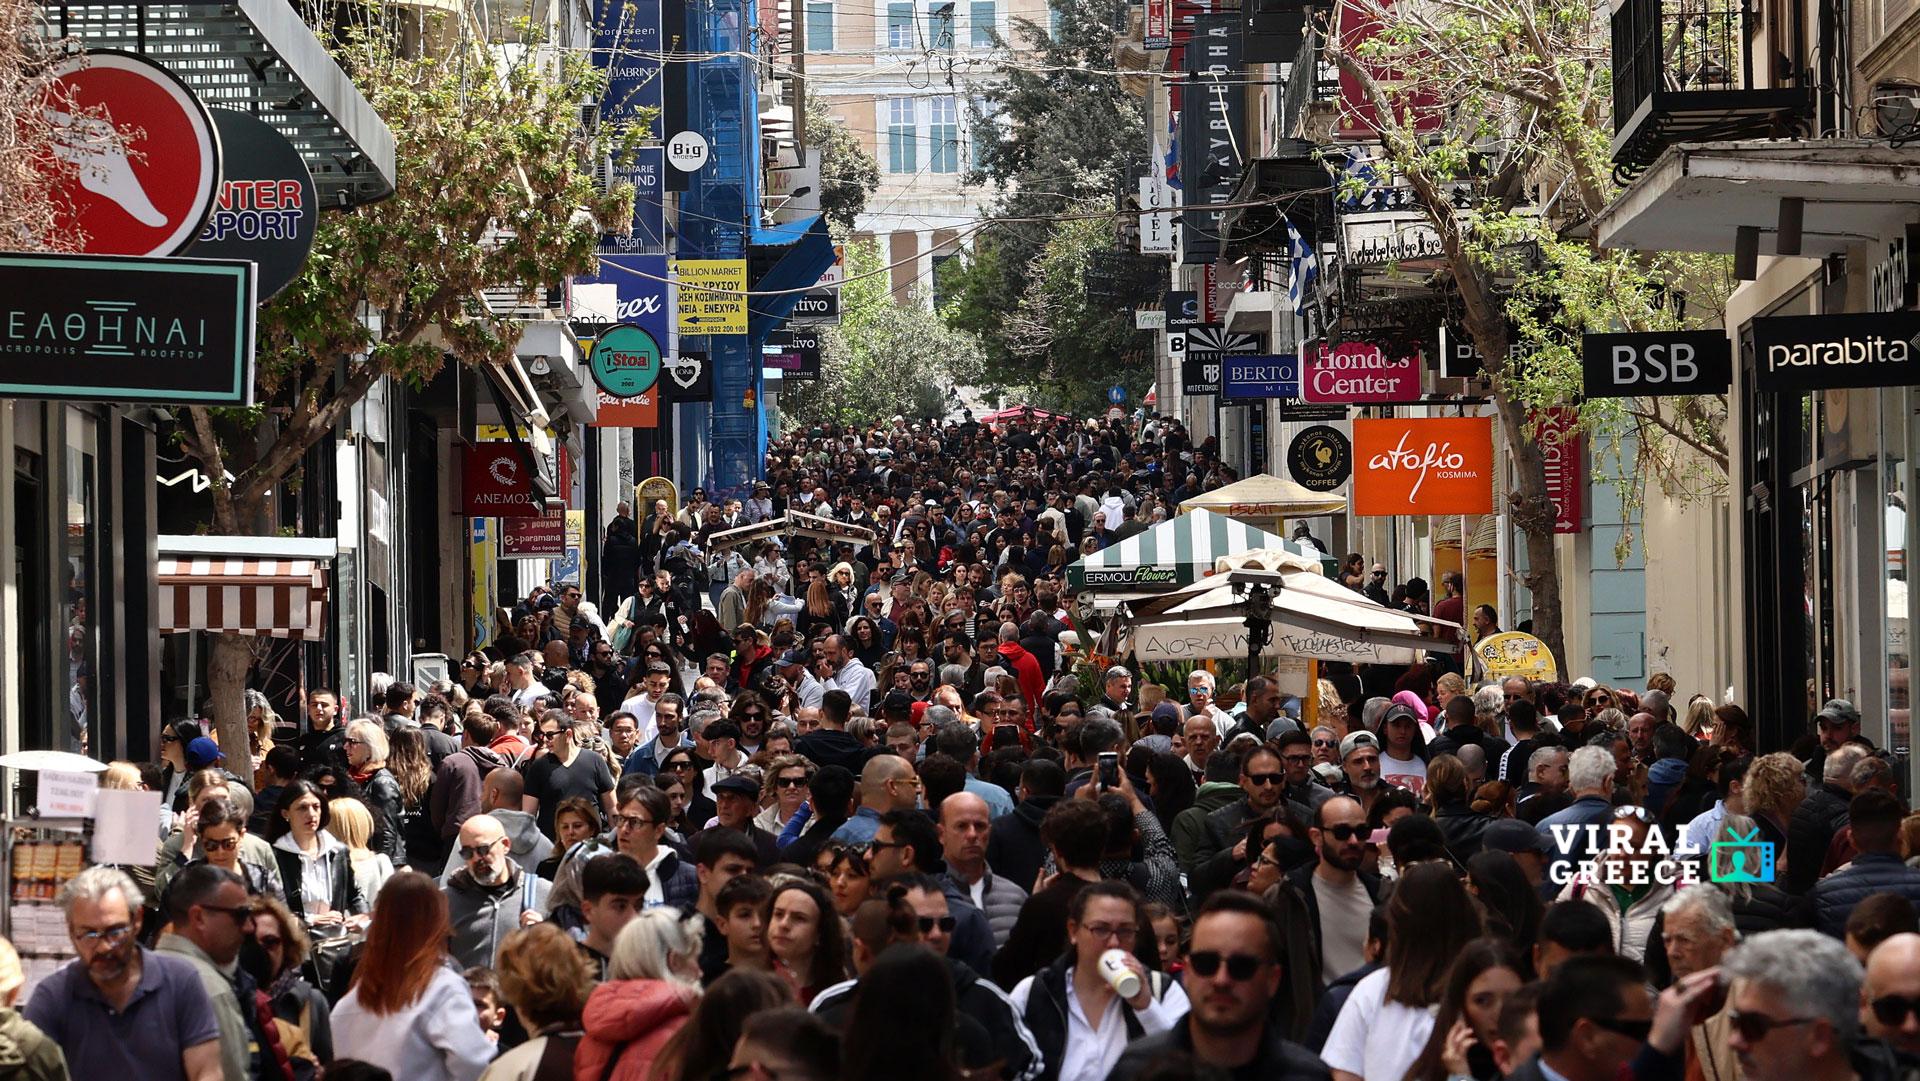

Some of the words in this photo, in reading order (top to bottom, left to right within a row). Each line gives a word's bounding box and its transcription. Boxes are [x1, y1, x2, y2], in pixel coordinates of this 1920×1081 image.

[599, 27, 655, 36] norgeen
[673, 144, 702, 157] Big
[614, 236, 643, 250] Vegan
[680, 267, 710, 276] BILLION
[711, 267, 742, 275] MARKET
[1217, 281, 1244, 289] ecco
[704, 304, 740, 313] ΕΝΕΧΥΡΑ
[141, 349, 204, 359] ROOFTOP
[606, 351, 648, 366] iStoa
[1768, 335, 1908, 372] parabita
[1611, 343, 1699, 385] BSB
[1231, 366, 1292, 381] BERTO
[1313, 370, 1401, 396] Center
[1436, 471, 1478, 479] KOSMIMA
[474, 493, 532, 504] ΑΝΕΜΟΣ
[504, 534, 561, 546] e-paramana
[1086, 572, 1132, 583] ERMOU
[1134, 566, 1175, 581] Flower
